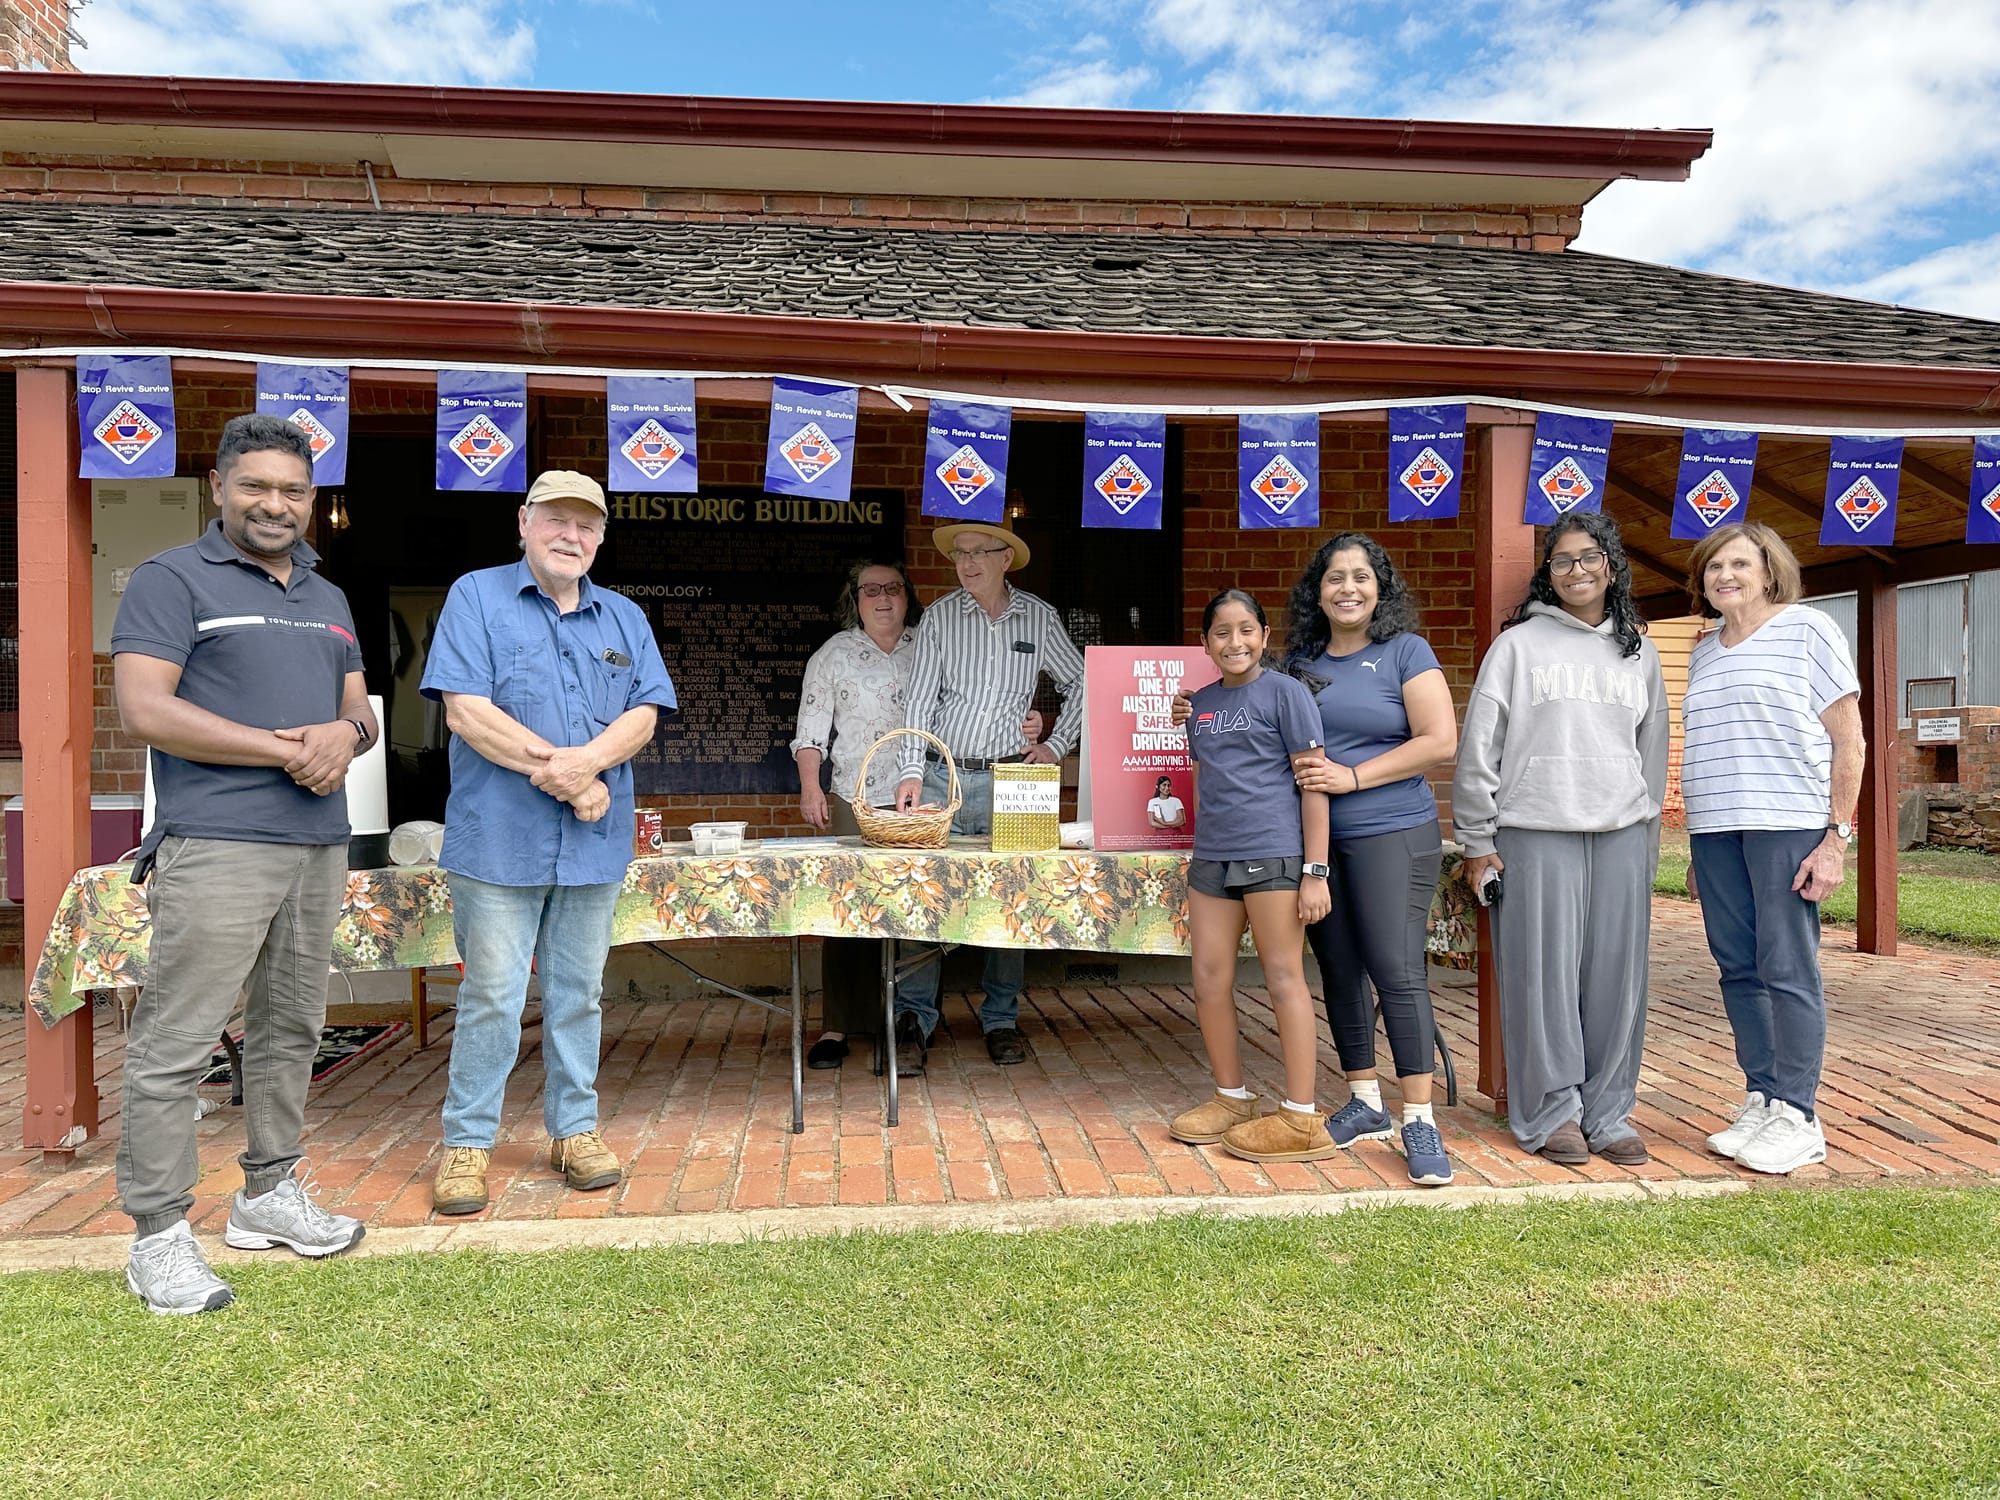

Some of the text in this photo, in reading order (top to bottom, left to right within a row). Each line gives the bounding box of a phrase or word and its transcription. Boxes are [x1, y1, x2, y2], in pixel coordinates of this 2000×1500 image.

[81, 386, 101, 394] Stop
[260, 393, 279, 401] Stop
[440, 398, 459, 406] Stop
[775, 403, 853, 419] Stop Revive Survive
[98, 408, 125, 436] DRIVER
[122, 404, 158, 435] REVIVER
[453, 423, 480, 448] DRIVER
[478, 418, 509, 449] REVIVER
[625, 428, 651, 453] DRIVER
[648, 423, 679, 453] REVIVER
[784, 431, 811, 452] DRIVER
[931, 427, 1006, 441] Stop Revive Survive
[809, 426, 837, 459] REVIVER
[1088, 439, 1104, 447] Stop
[1536, 439, 1606, 454] Stop Revive Survive
[1684, 454, 1700, 462] Stop
[1729, 457, 1753, 465] Survive
[611, 492, 883, 524] HISTORIC BUILDING
[748, 604, 760, 612] THE
[1133, 660, 1184, 677] ARE YOU
[1139, 678, 1180, 695] ONE OF
[1531, 663, 1648, 712] MIAMI
[1143, 715, 1179, 729] SAFES
[1195, 708, 1251, 735] FILA
[1122, 756, 1150, 766] AAMI
[1152, 756, 1183, 765] DRIVING
[996, 793, 1027, 801] POLICE
[1002, 804, 1050, 812] DONATION
